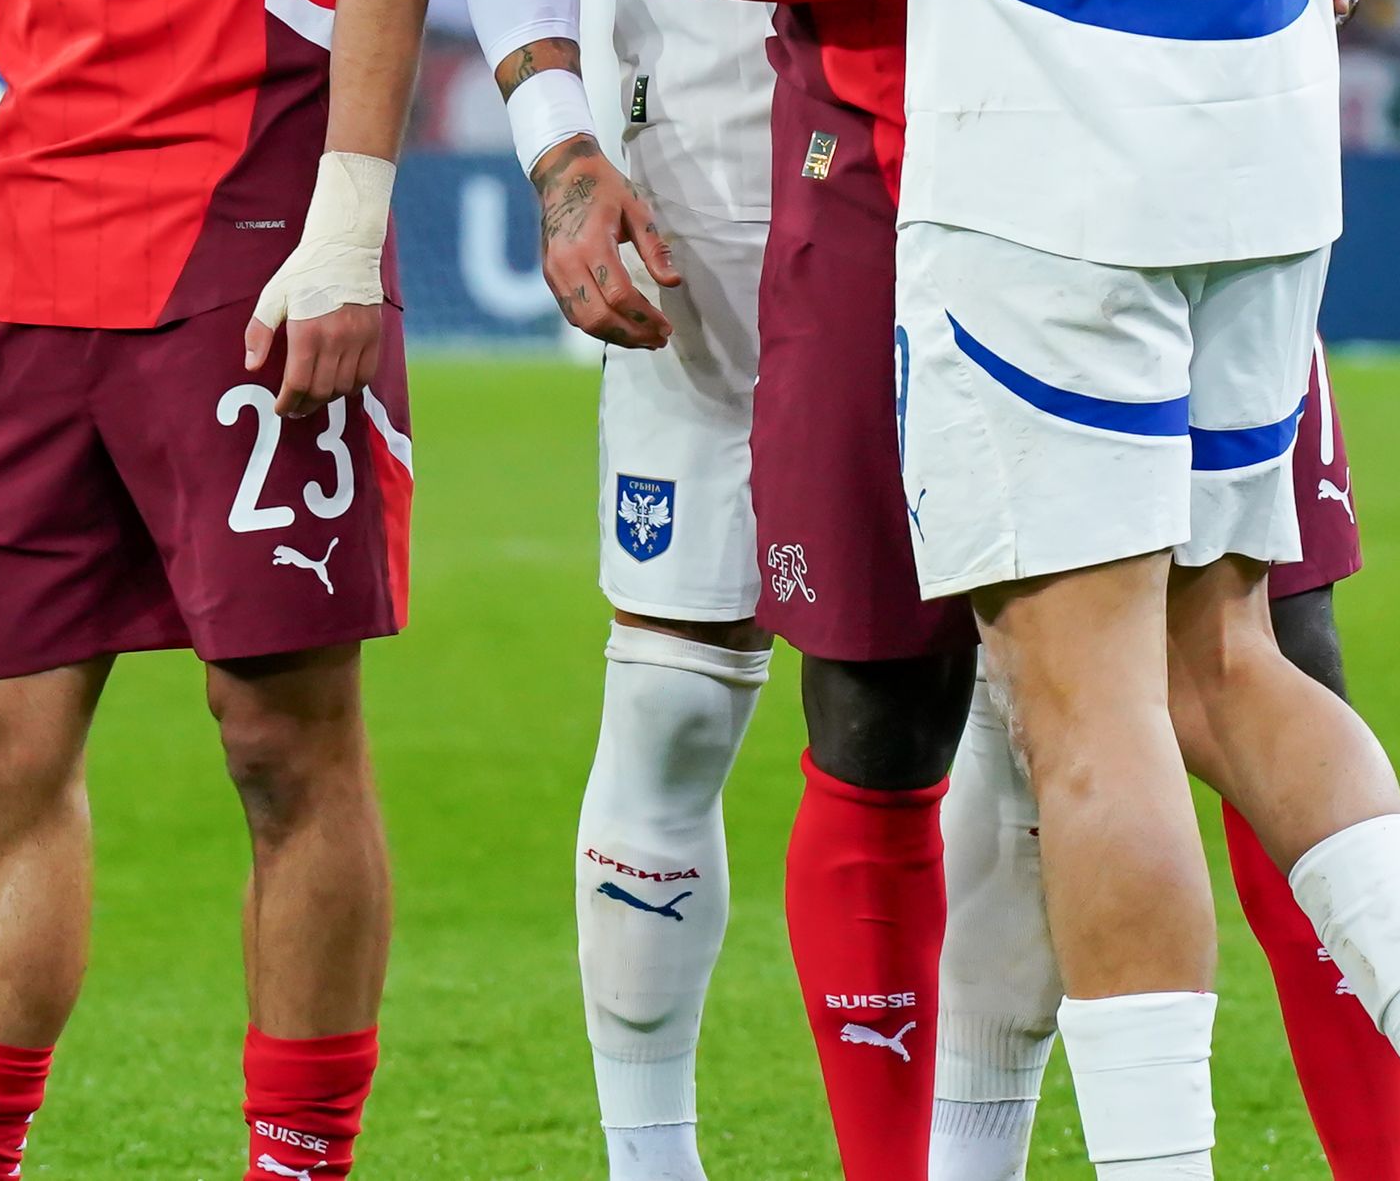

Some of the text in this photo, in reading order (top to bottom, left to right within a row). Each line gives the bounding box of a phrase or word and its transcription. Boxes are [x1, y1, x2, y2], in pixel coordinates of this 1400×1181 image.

[216, 383, 355, 533] 23
[825, 992, 916, 1010] SUISSE
[255, 1119, 329, 1154] SUISSE
